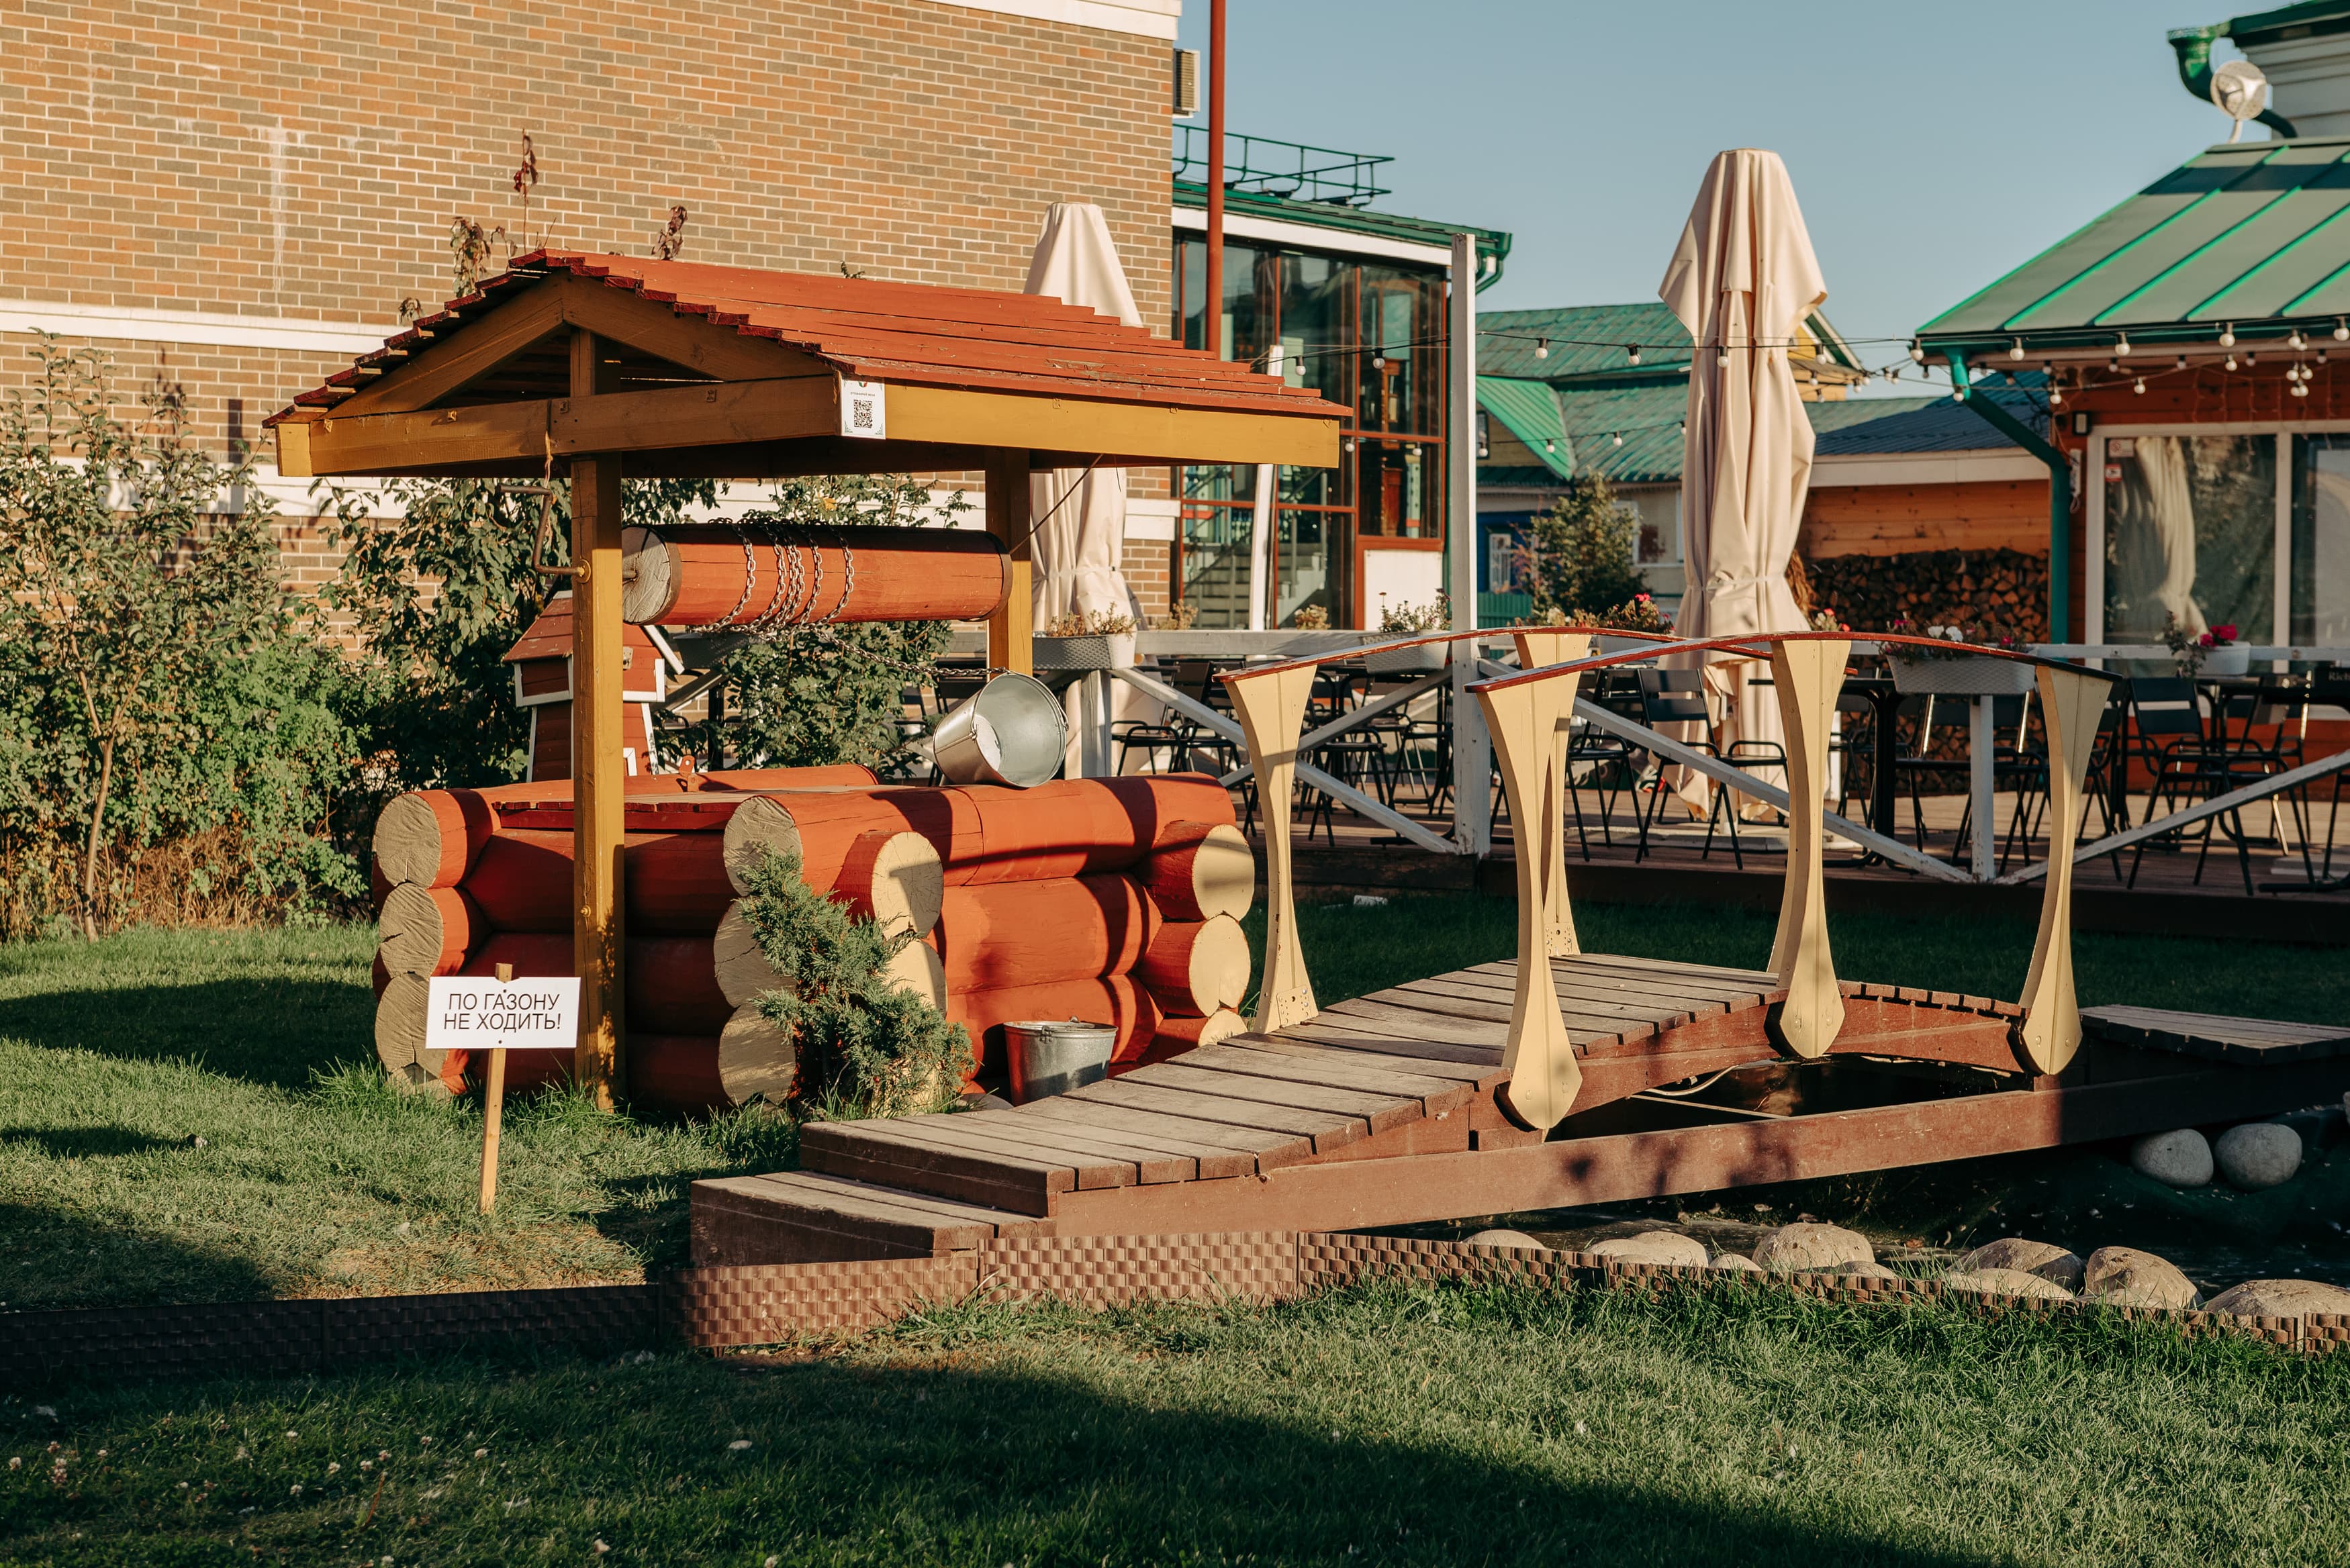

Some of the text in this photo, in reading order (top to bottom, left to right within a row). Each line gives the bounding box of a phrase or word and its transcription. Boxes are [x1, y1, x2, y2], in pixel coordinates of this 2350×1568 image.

[449, 993, 560, 1010] ПО ГАЗОНУ
[444, 1013, 561, 1033] НЕ ХОДИТЬ!
